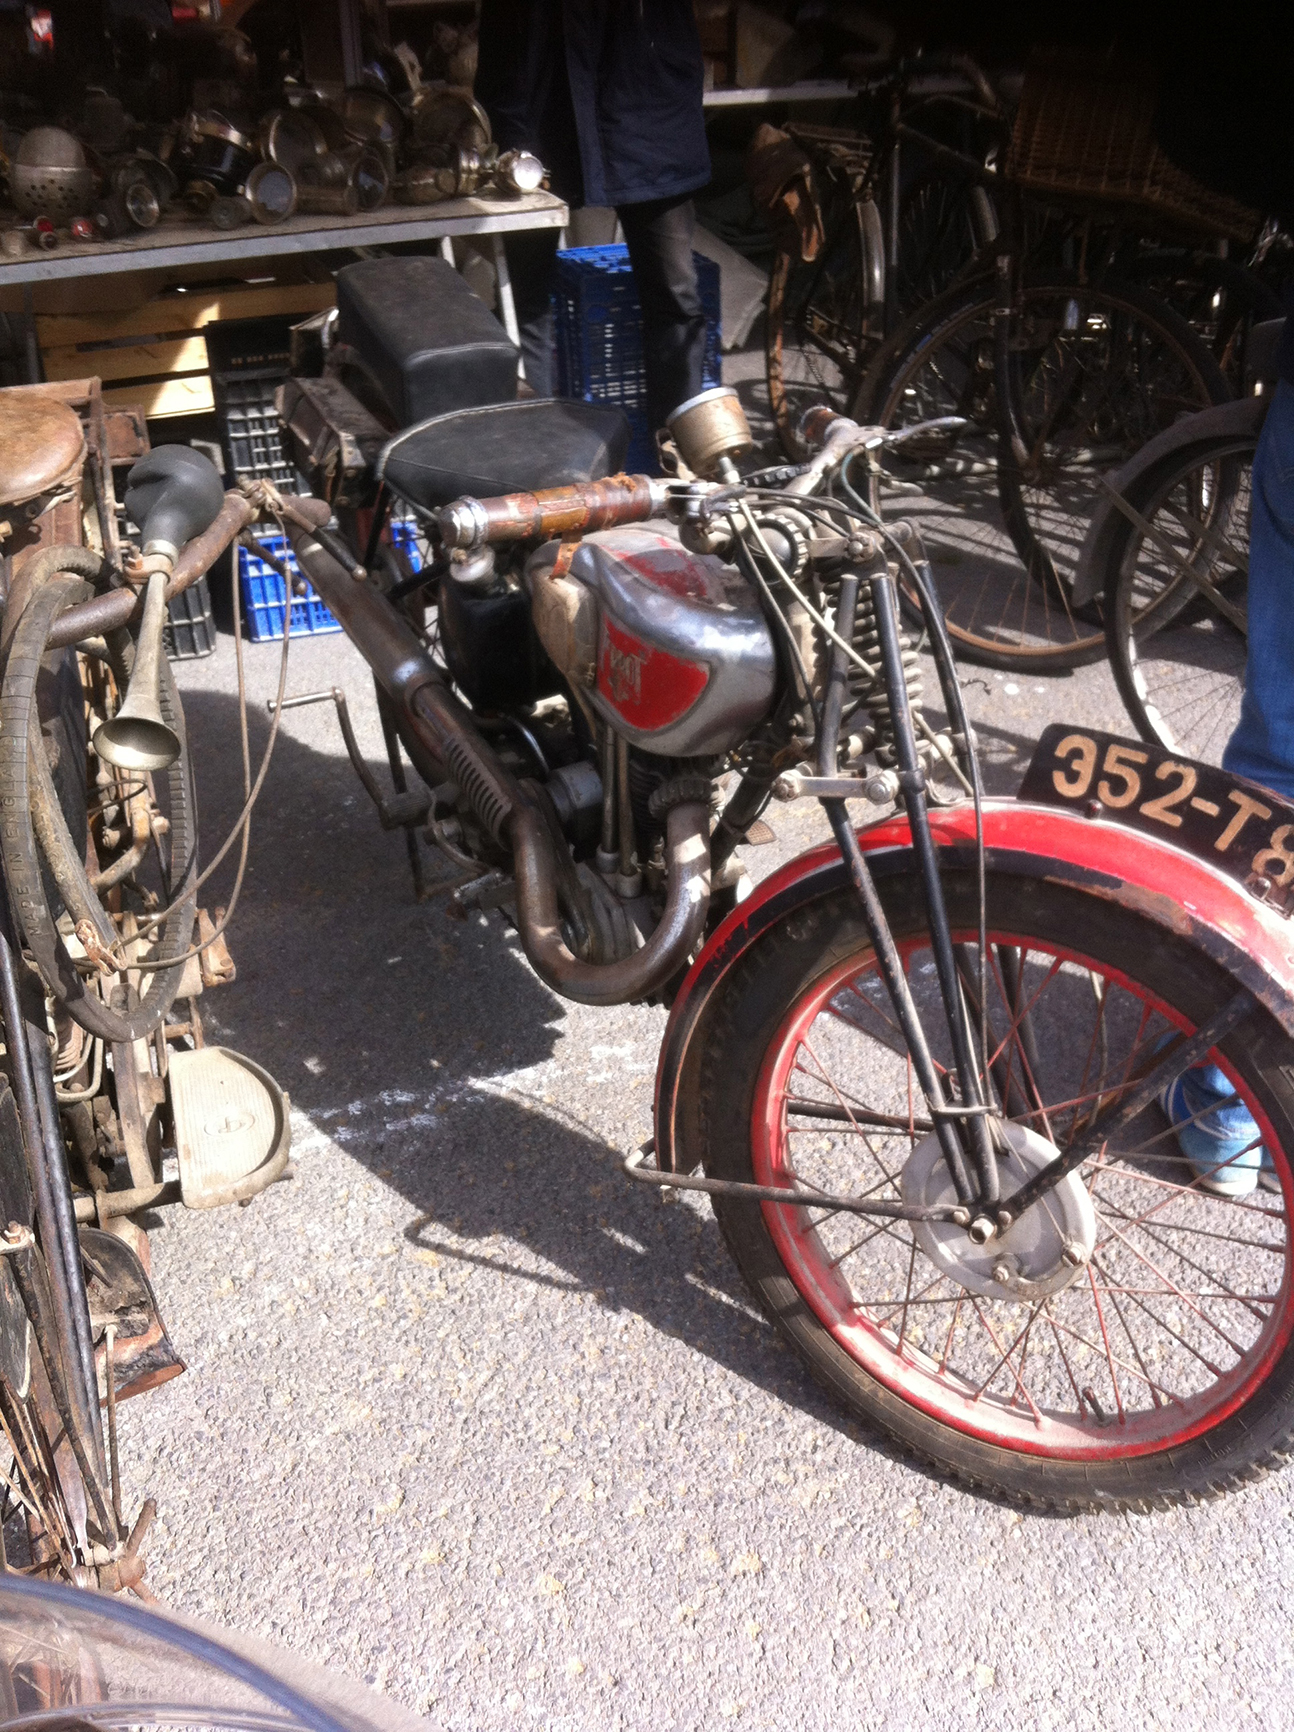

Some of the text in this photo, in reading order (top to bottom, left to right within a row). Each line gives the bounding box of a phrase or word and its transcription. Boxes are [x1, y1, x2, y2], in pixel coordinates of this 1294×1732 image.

[1052, 734, 1294, 887] 352-T8
[9, 852, 24, 871] IN
[17, 886, 42, 936] MADE
